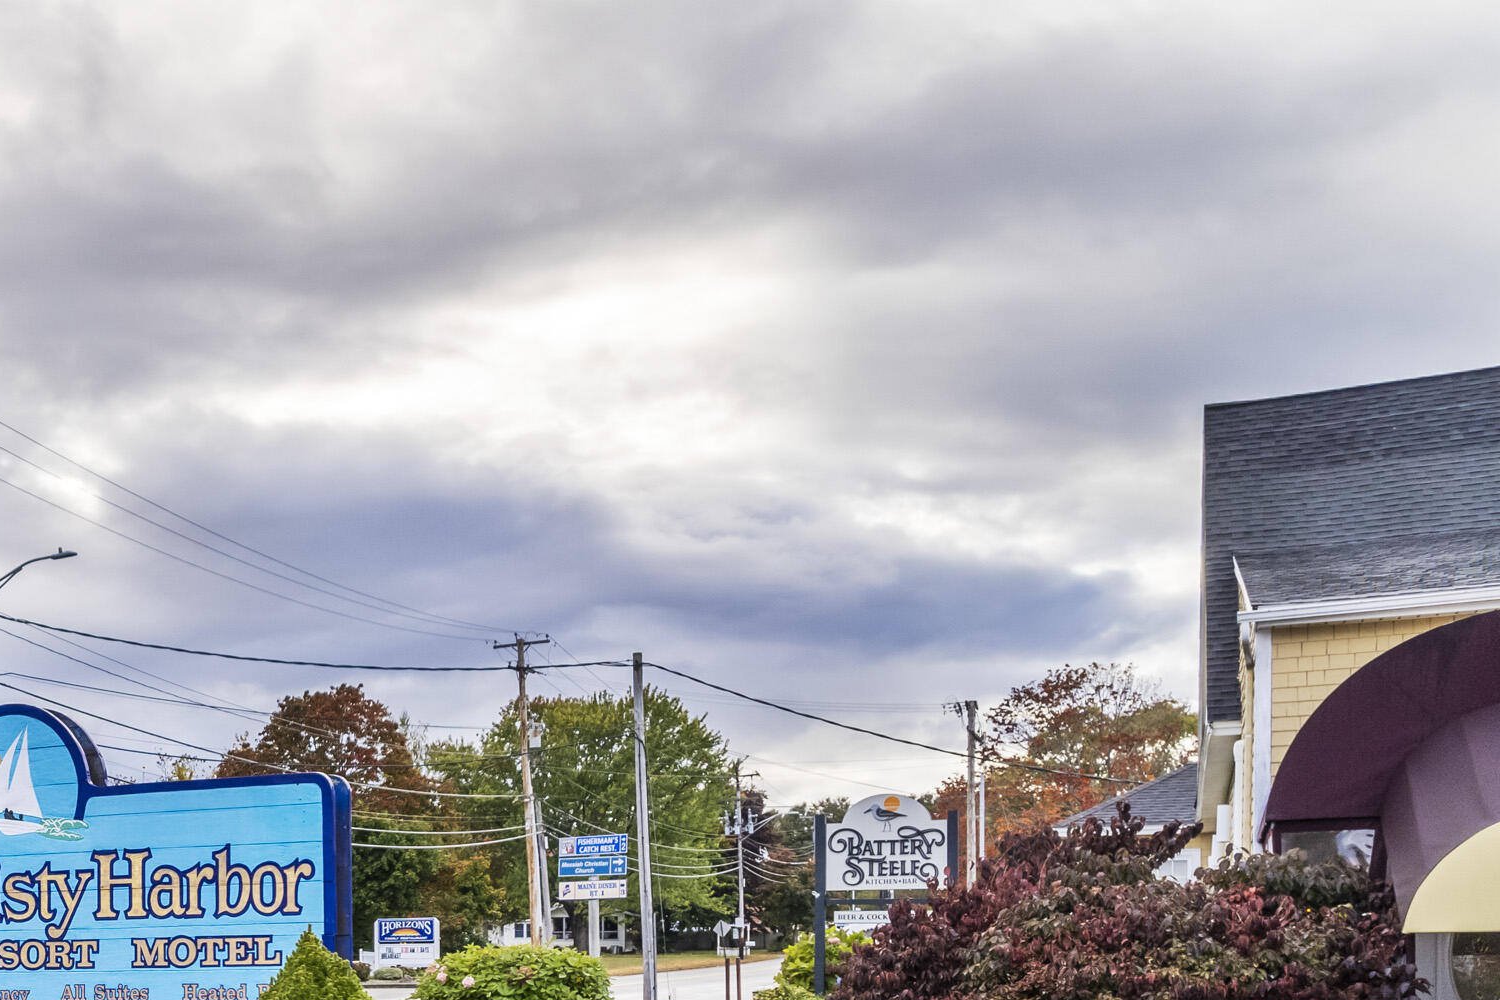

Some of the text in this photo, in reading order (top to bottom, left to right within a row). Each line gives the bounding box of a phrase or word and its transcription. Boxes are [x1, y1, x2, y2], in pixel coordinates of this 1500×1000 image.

[578, 837, 618, 845] FISHERMAN'S
[621, 842, 626, 850] 2
[828, 826, 945, 859] BATTERY
[91, 844, 315, 920] Harbor
[842, 856, 939, 886] STEELE
[382, 921, 431, 936] HORIZONS
[131, 935, 283, 968] MOTEL
